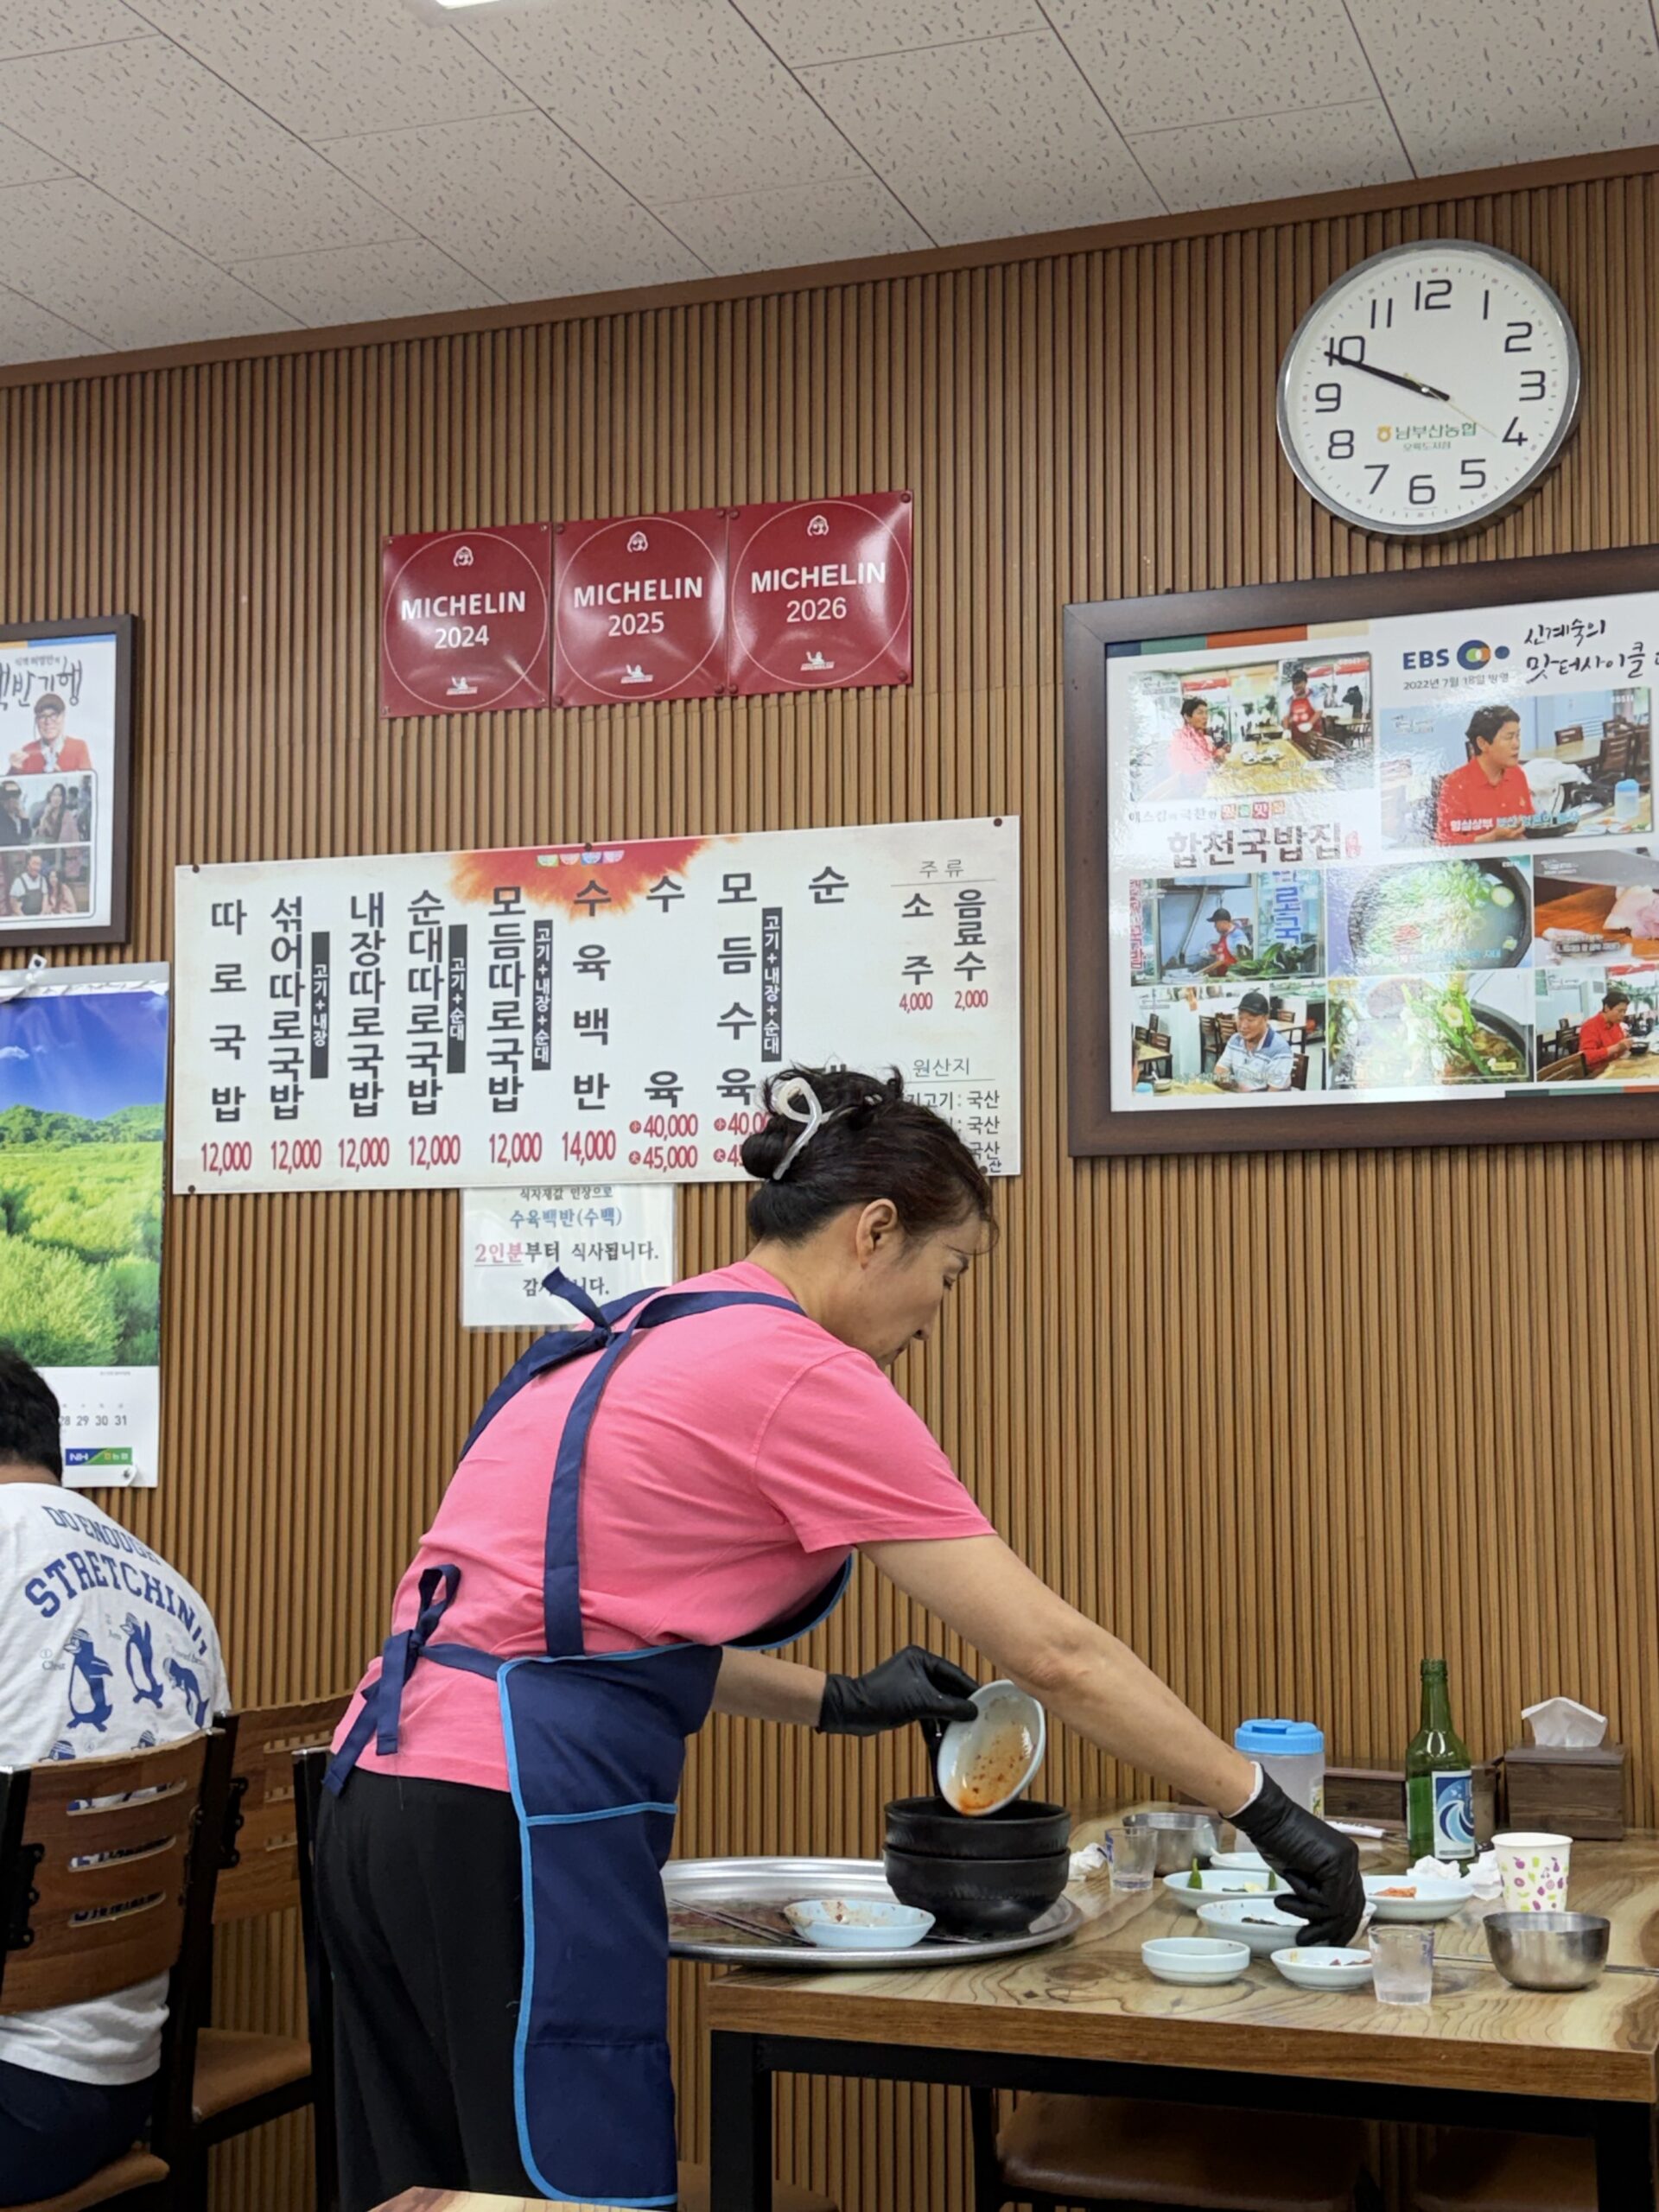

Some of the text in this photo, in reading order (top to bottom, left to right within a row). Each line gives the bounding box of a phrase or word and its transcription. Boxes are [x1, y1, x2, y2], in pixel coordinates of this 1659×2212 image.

[1414, 279, 1452, 311] 12
[1483, 289, 1489, 320] 1
[1370, 297, 1393, 329] 11
[1328, 335, 1365, 366] 10
[1504, 321, 1532, 353] 2
[1315, 382, 1341, 413] 9
[1519, 371, 1545, 401] 3
[1328, 429, 1354, 460] 8
[1395, 423, 1477, 440] 남부산농협
[1502, 416, 1528, 446] 4
[1363, 464, 1389, 494] 7
[1459, 459, 1486, 489] 5
[1408, 474, 1435, 505] 6
[574, 576, 702, 608] MICHELIN
[751, 562, 887, 594] MICHELIN
[401, 591, 526, 620] MICHELIN
[786, 597, 847, 623] 2026
[435, 626, 489, 650] 2024
[607, 611, 664, 637] 2025
[1524, 619, 1605, 646] 신계숙의
[1402, 649, 1449, 671] EBS
[1526, 641, 1645, 683] 맛터사이클
[1403, 677, 1440, 690] 2022년
[1442, 676, 1459, 688] 7월
[1167, 823, 1340, 868] 합천국밥집
[919, 859, 964, 878] 주류
[901, 893, 934, 986] 소주
[954, 888, 986, 982] 음료수
[347, 892, 386, 1117] 내장따로국밥
[406, 889, 445, 1116] 순대따로국밥
[486, 886, 526, 1113] 모듬따로국밥
[572, 880, 612, 1111] 수육백반
[716, 873, 757, 1106] 모듬수육
[899, 992, 933, 1014] 4,000
[954, 989, 988, 1012] 2,000
[210, 899, 247, 1122] 따로국밥
[268, 896, 305, 1121] 섞어따로국밥
[912, 1057, 969, 1078] 원산지
[967, 1090, 1000, 1109] 국산
[643, 1114, 698, 1141] 40,000
[728, 1111, 770, 1136] 40,00
[967, 1115, 1000, 1135] 국산
[201, 1141, 252, 1176] 12,000
[270, 1139, 322, 1174] 12,000
[338, 1136, 390, 1173] 12,000
[409, 1134, 461, 1171] 12,000
[489, 1132, 542, 1168] 12,000
[562, 1130, 616, 1166] 14,000
[643, 1145, 698, 1173] 45,000
[969, 1141, 1000, 1160] 국산
[988, 1160, 1001, 1173] 산
[519, 1185, 613, 1202] 식자재값 인상으로
[510, 1206, 622, 1229] 수육백반(수백)
[474, 1240, 659, 1263] 2인분부터 식사됩니다.
[76, 1415, 89, 1427] 29
[95, 1415, 108, 1427] 30
[115, 1414, 127, 1426] 31
[69, 1452, 88, 1462] NH
[41, 1505, 80, 1531] DO
